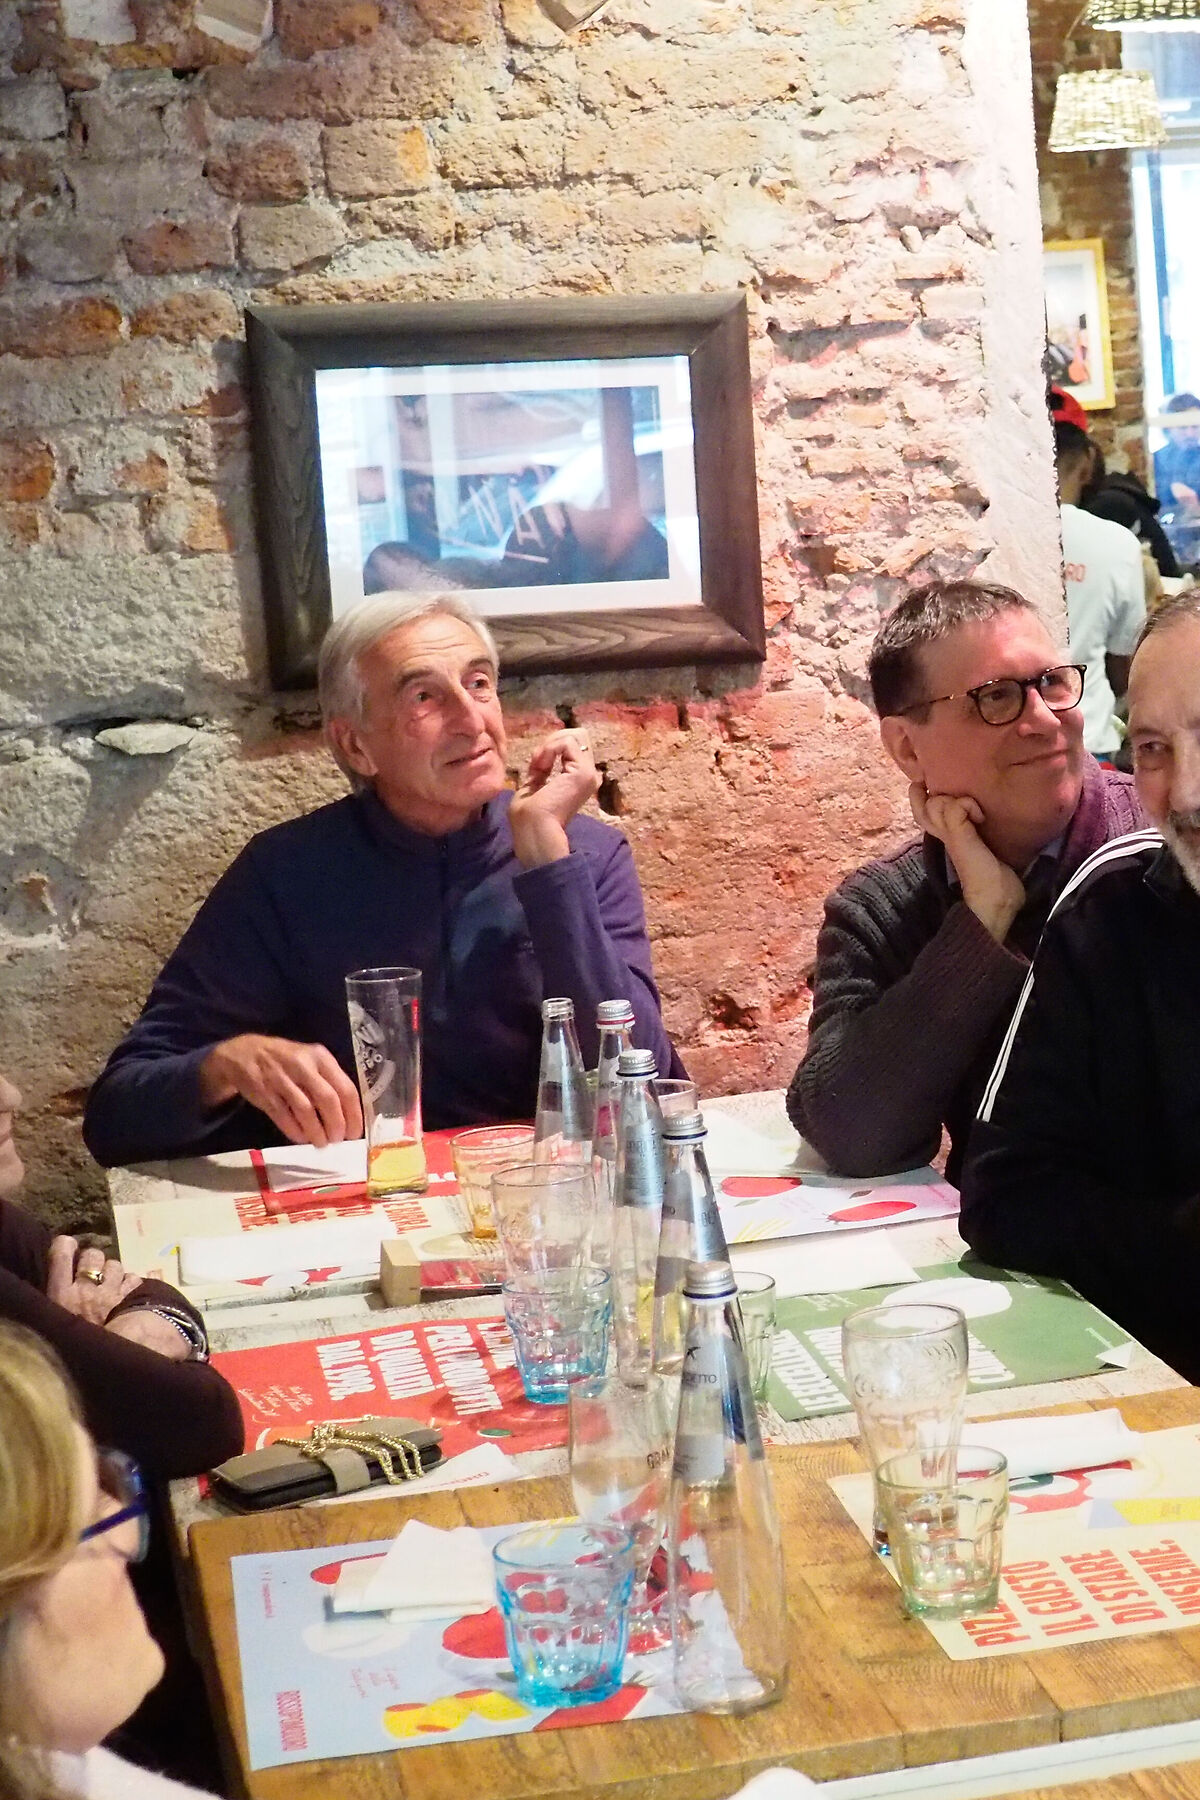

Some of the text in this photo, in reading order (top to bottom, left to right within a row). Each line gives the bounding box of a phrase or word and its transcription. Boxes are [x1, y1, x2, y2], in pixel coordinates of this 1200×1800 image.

[315, 1339, 365, 1368] DAL
[369, 1329, 417, 1351] DI
[435, 1352, 503, 1415] PRODOTTI
[1000, 1560, 1100, 1637] IL GUSTO
[1060, 1549, 1168, 1625] DI STARE
